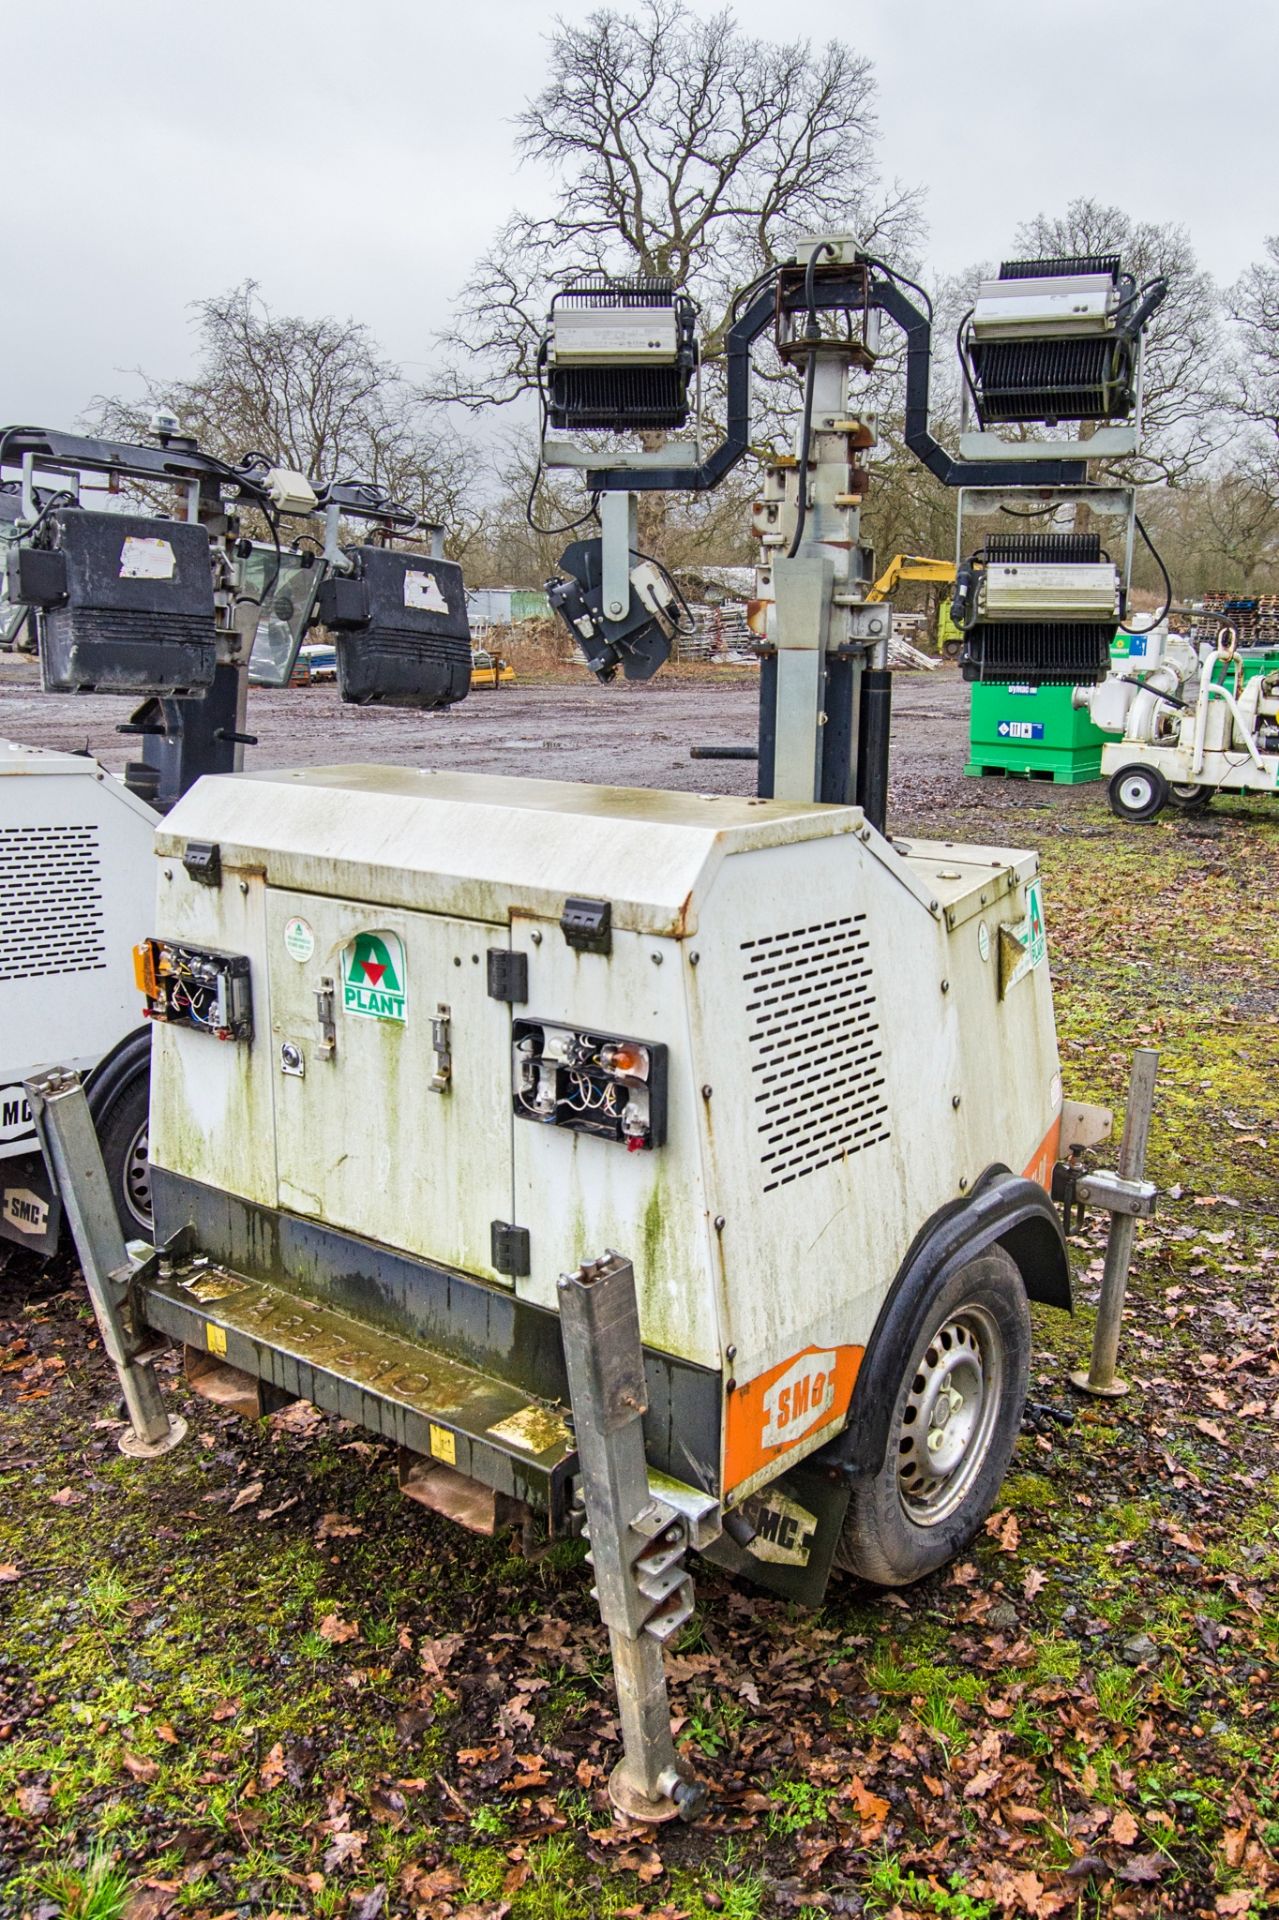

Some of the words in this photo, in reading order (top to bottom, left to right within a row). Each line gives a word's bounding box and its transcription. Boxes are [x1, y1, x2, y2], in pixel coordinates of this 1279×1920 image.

[348, 932, 401, 992] A
[344, 986, 405, 1018] PLANT
[11, 1197, 40, 1226] SMC
